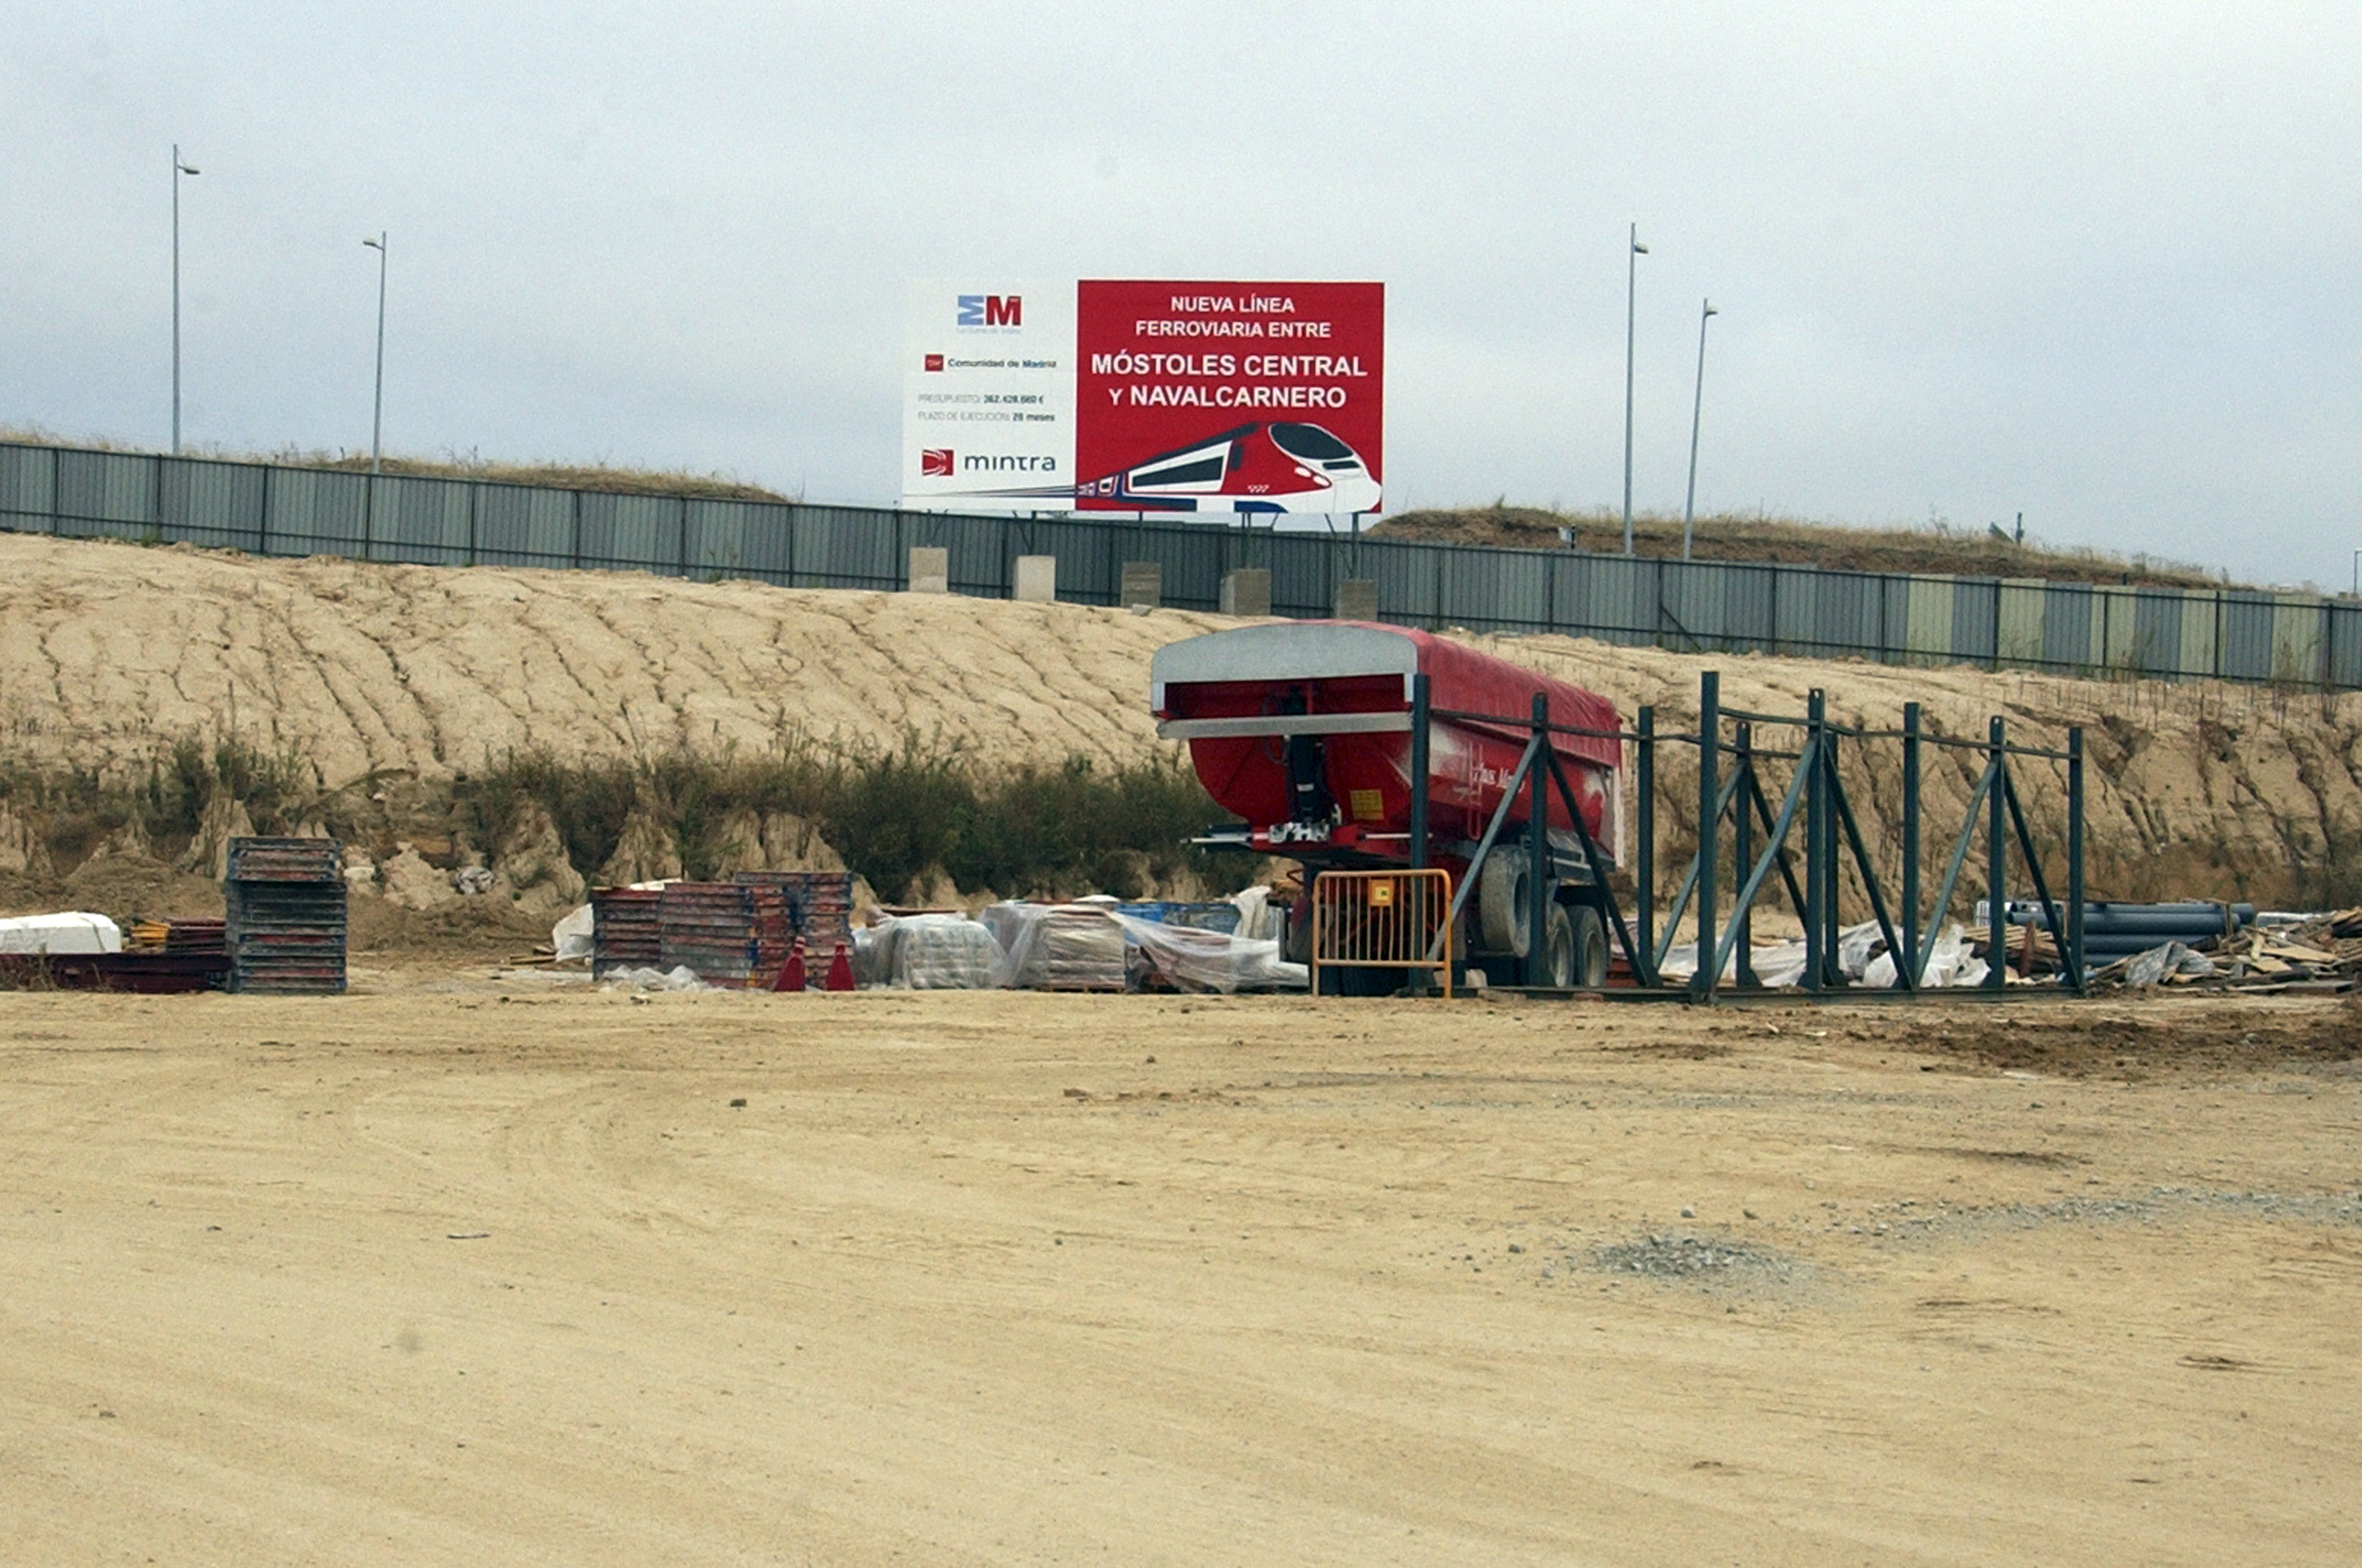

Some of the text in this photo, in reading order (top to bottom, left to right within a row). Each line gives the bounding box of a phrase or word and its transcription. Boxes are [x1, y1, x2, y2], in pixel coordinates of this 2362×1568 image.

[1171, 293, 1295, 313] NUEVA LÍNEA
[1135, 320, 1331, 338] FERROVIARIA ENTRE
[948, 358, 1056, 368] Comunidad de Madrid
[1091, 349, 1368, 376] MÓSTOLES CENTRAL
[1109, 385, 1346, 408] Y NAVALCARNERO
[964, 454, 1057, 471] mintra
